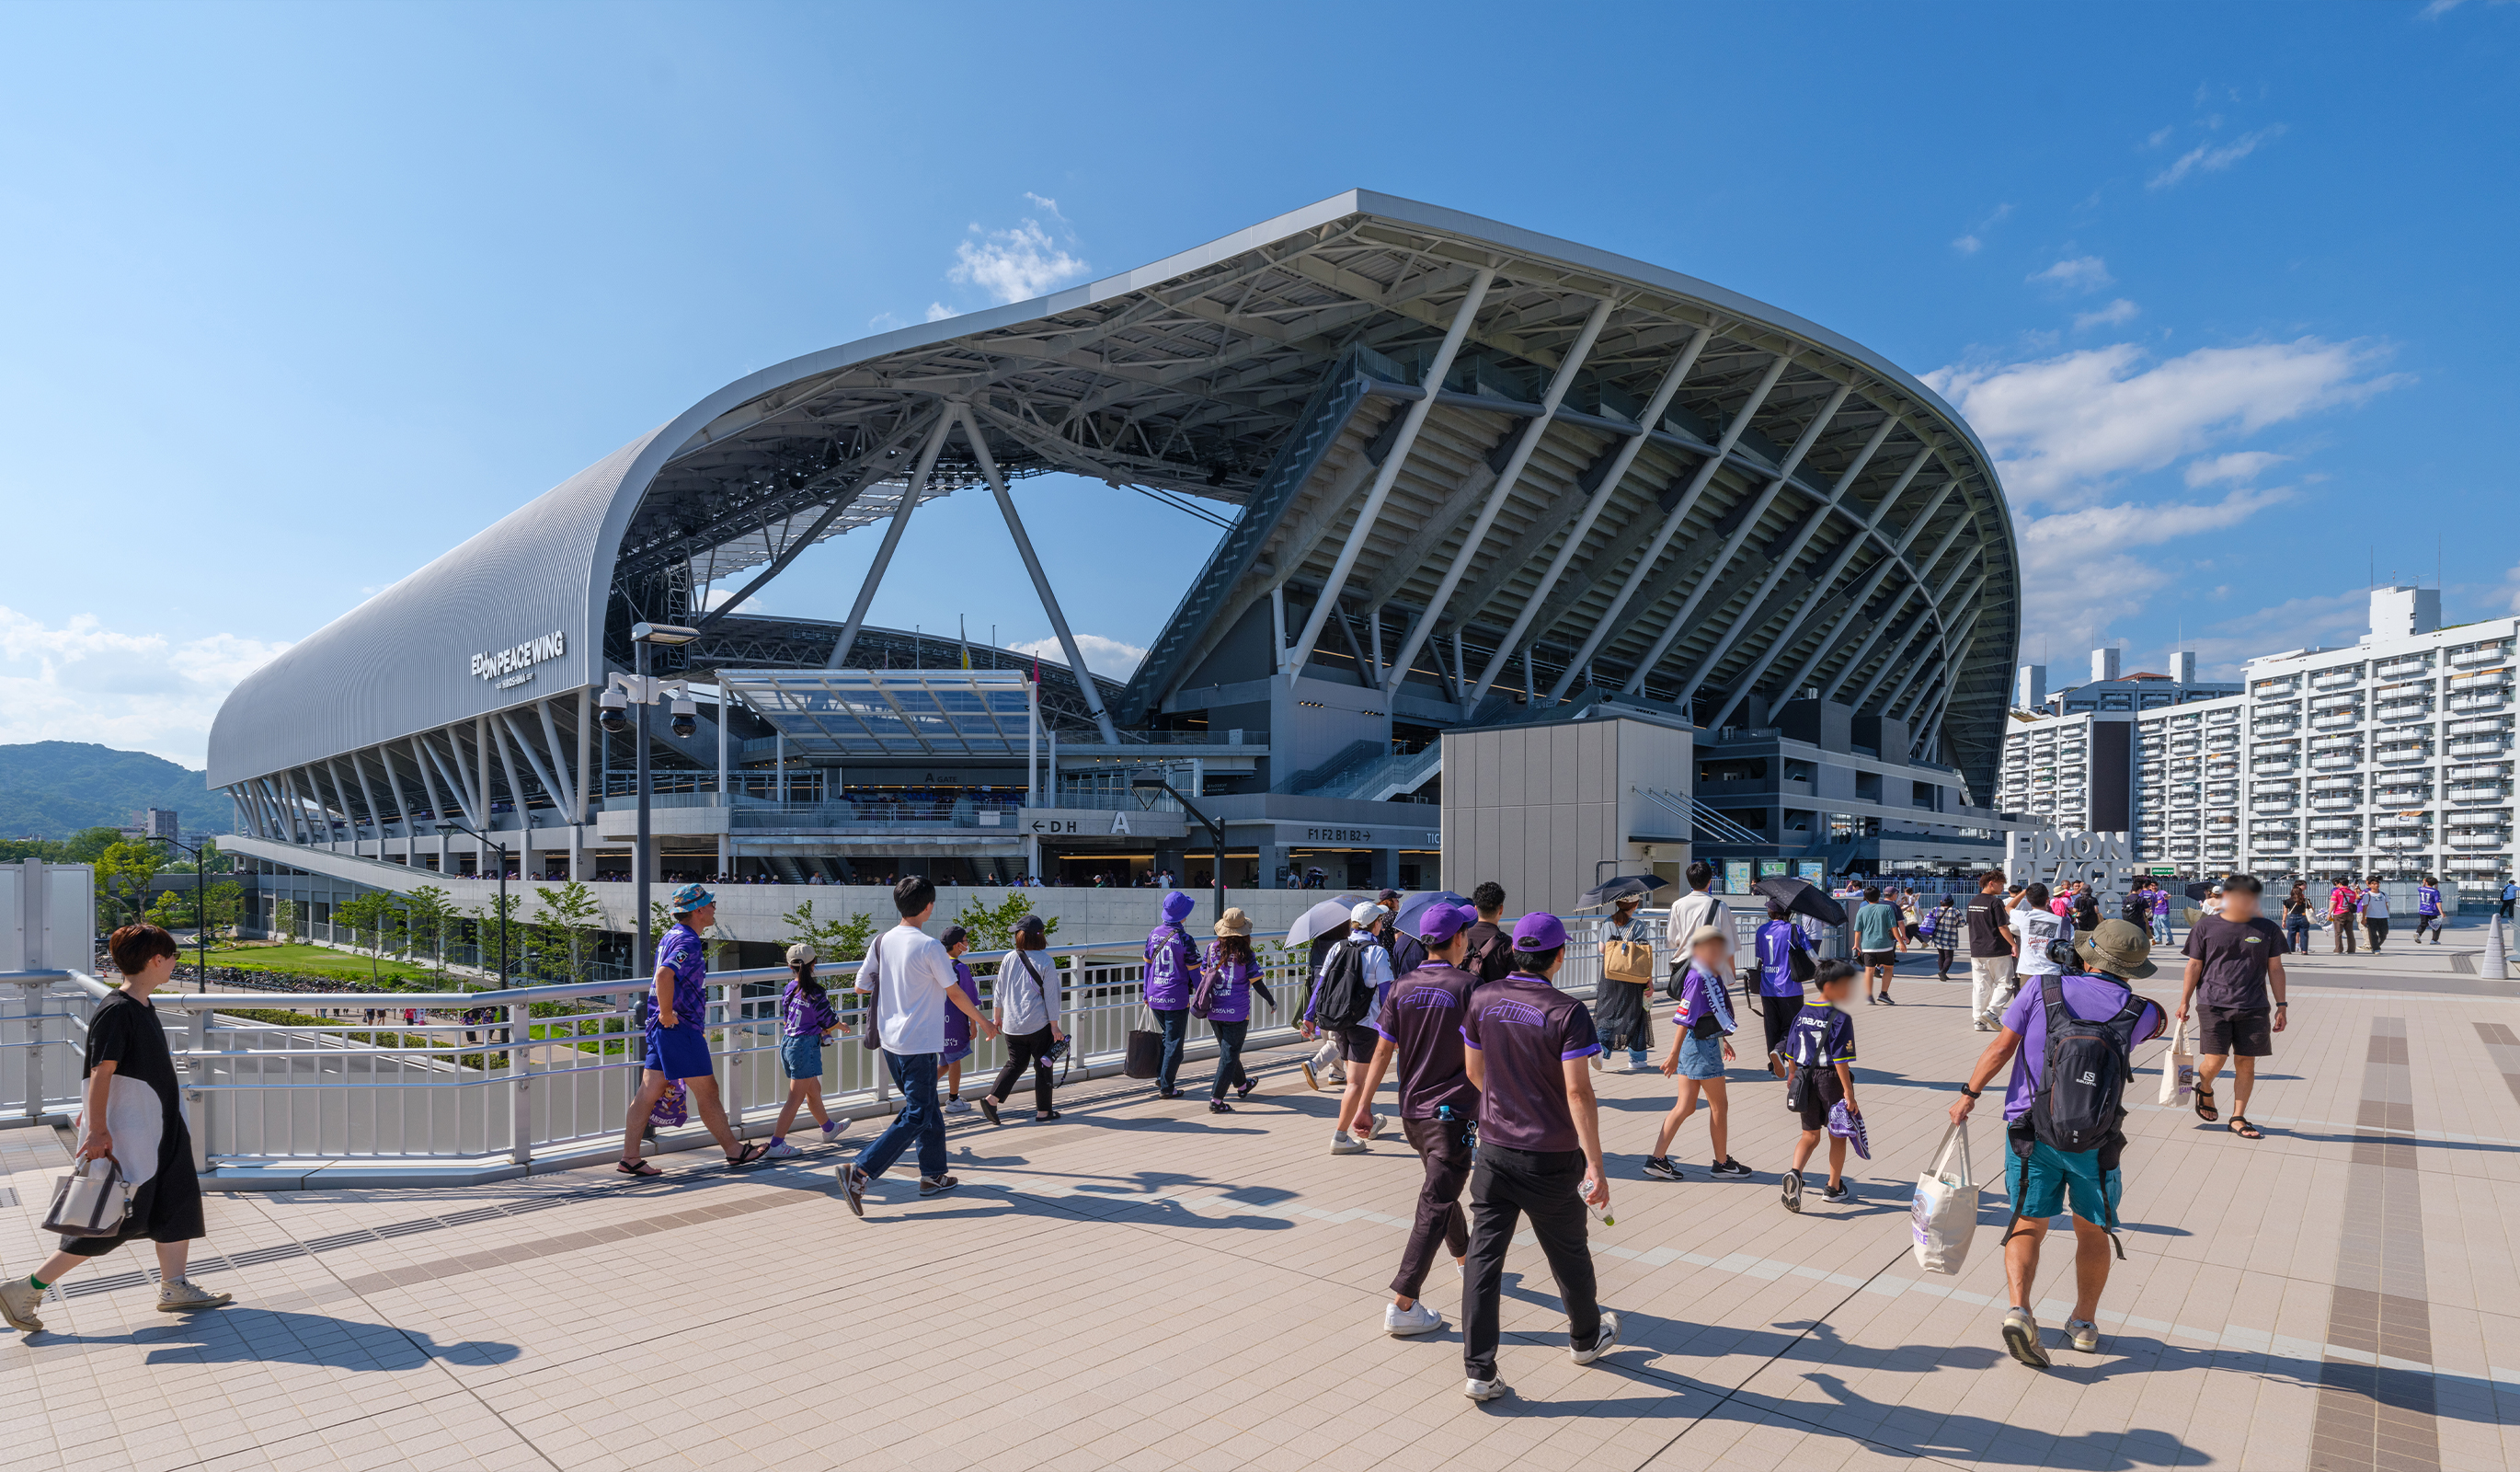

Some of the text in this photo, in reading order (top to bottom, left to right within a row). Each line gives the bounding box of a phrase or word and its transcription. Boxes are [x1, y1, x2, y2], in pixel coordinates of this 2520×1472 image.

[498, 644, 532, 675] PEACE
[531, 630, 565, 663] WING
[924, 773, 934, 783] A
[1050, 821, 1077, 833] D H
[1110, 811, 1131, 834] A
[1308, 829, 1361, 841] F1 F2 B1 B2
[2007, 831, 2131, 860] EDION
[2005, 860, 2133, 892] PEACE
[2421, 892, 2430, 903] 11
[1766, 935, 1774, 965] 1
